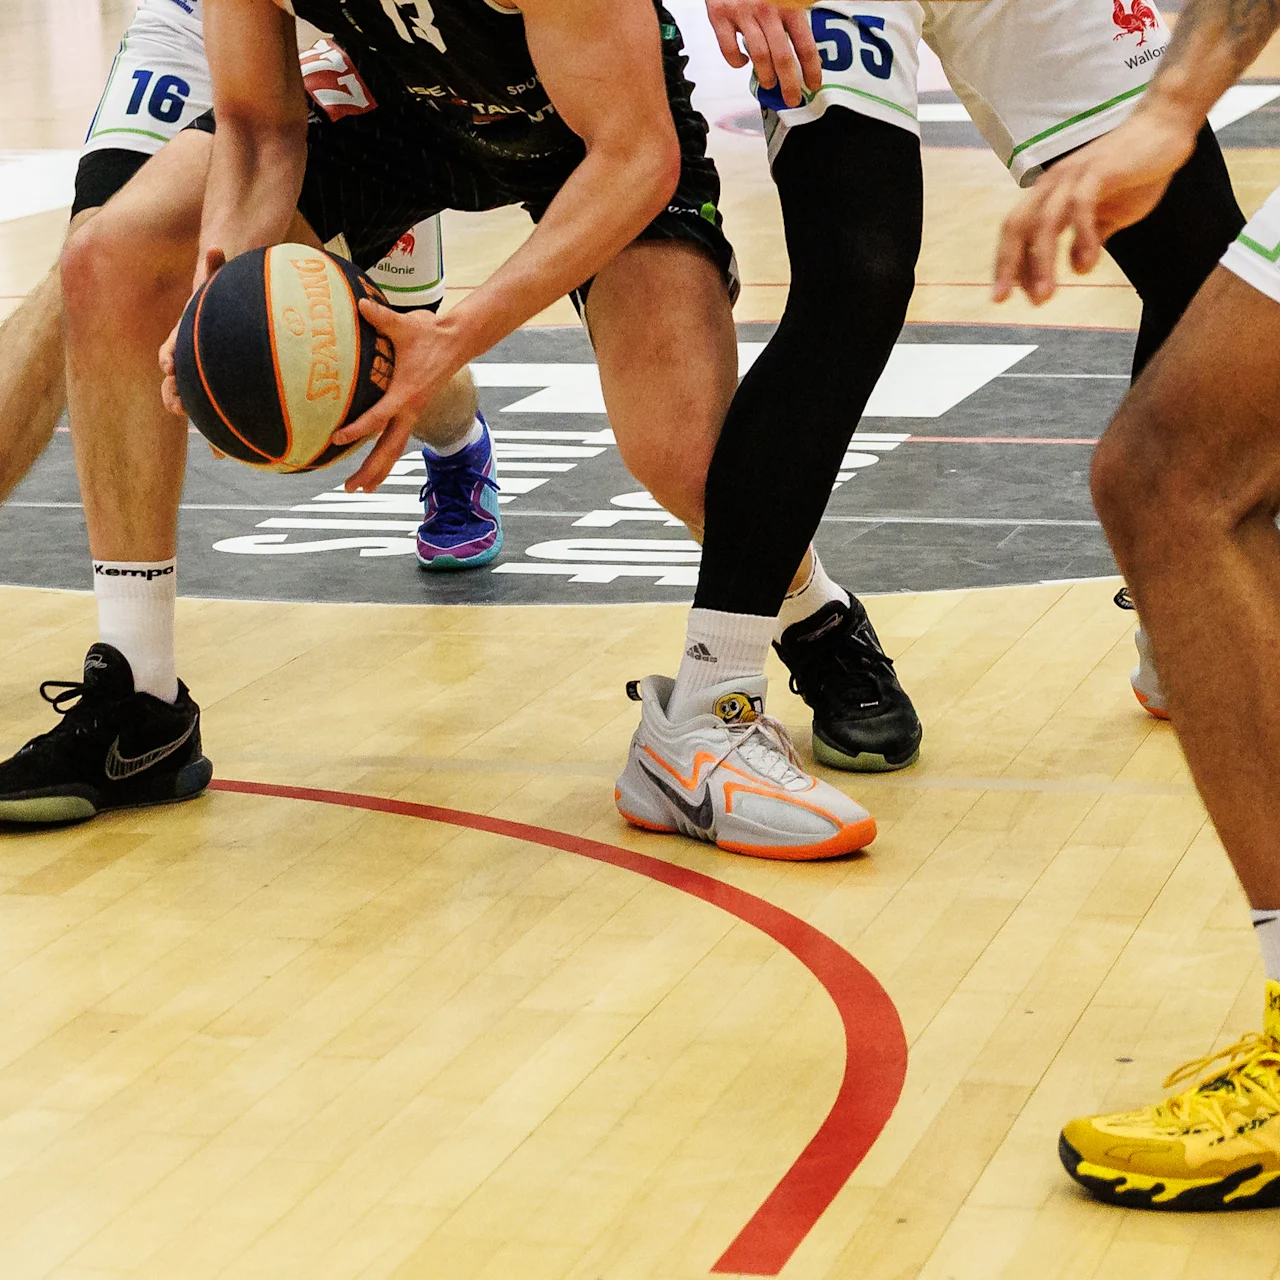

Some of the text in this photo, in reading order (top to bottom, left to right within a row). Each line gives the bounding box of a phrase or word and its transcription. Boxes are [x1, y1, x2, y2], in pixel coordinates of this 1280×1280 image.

[812, 7, 894, 80] 55
[125, 70, 191, 122] 16
[289, 257, 342, 402] SPALDING
[94, 563, 175, 581] Kempa
